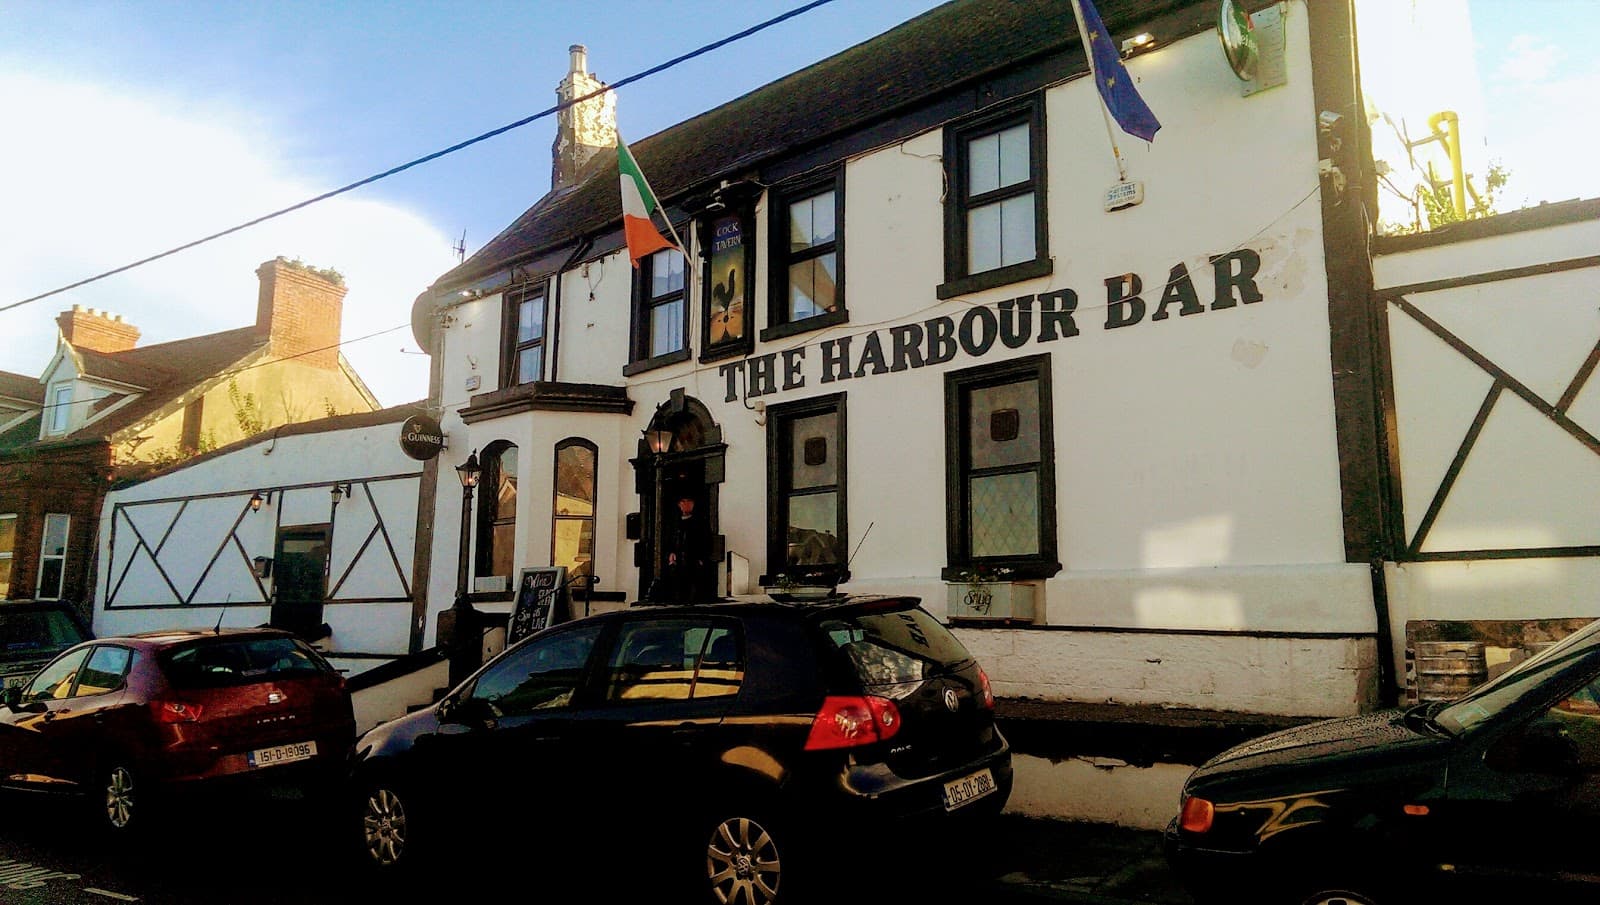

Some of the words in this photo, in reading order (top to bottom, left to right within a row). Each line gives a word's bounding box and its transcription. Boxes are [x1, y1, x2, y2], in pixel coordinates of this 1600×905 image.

[716, 222, 738, 237] COCK
[715, 234, 742, 251] TAVERN
[719, 348, 805, 402] THE
[820, 287, 1080, 383] HARBOUR
[1103, 248, 1264, 330] BAR
[408, 432, 441, 444] GUINNESS
